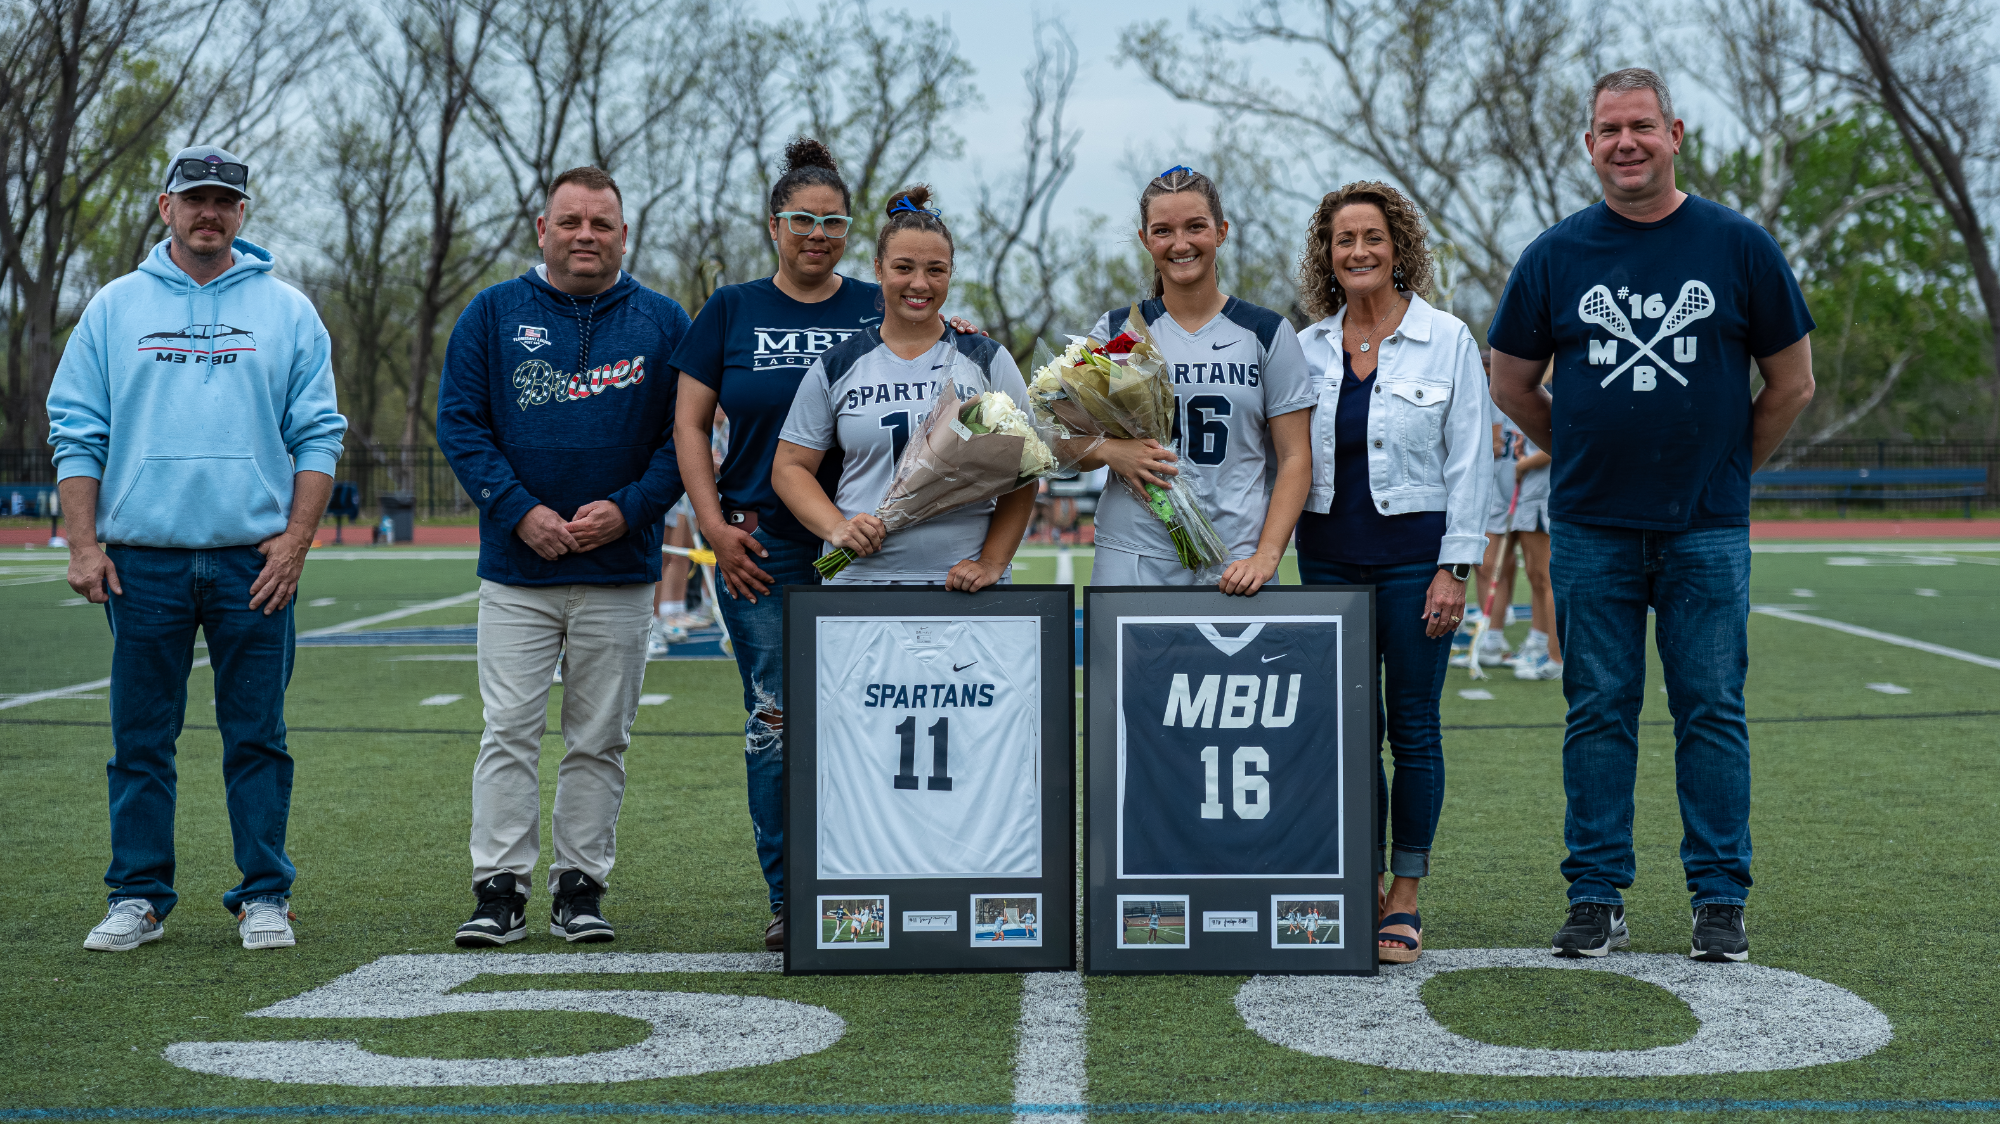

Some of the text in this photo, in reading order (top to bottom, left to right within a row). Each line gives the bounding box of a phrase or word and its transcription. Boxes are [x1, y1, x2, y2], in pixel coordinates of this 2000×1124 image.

[1617, 286, 1666, 319] #16
[754, 331, 853, 354] MB
[156, 352, 187, 364] M3
[754, 357, 811, 366] LACR
[513, 356, 645, 411] Braves
[1172, 362, 1259, 388] RTANS
[864, 683, 995, 709] SPARTANS
[1162, 673, 1302, 729] MBU
[893, 715, 953, 792] 11
[1200, 745, 1271, 820] 16
